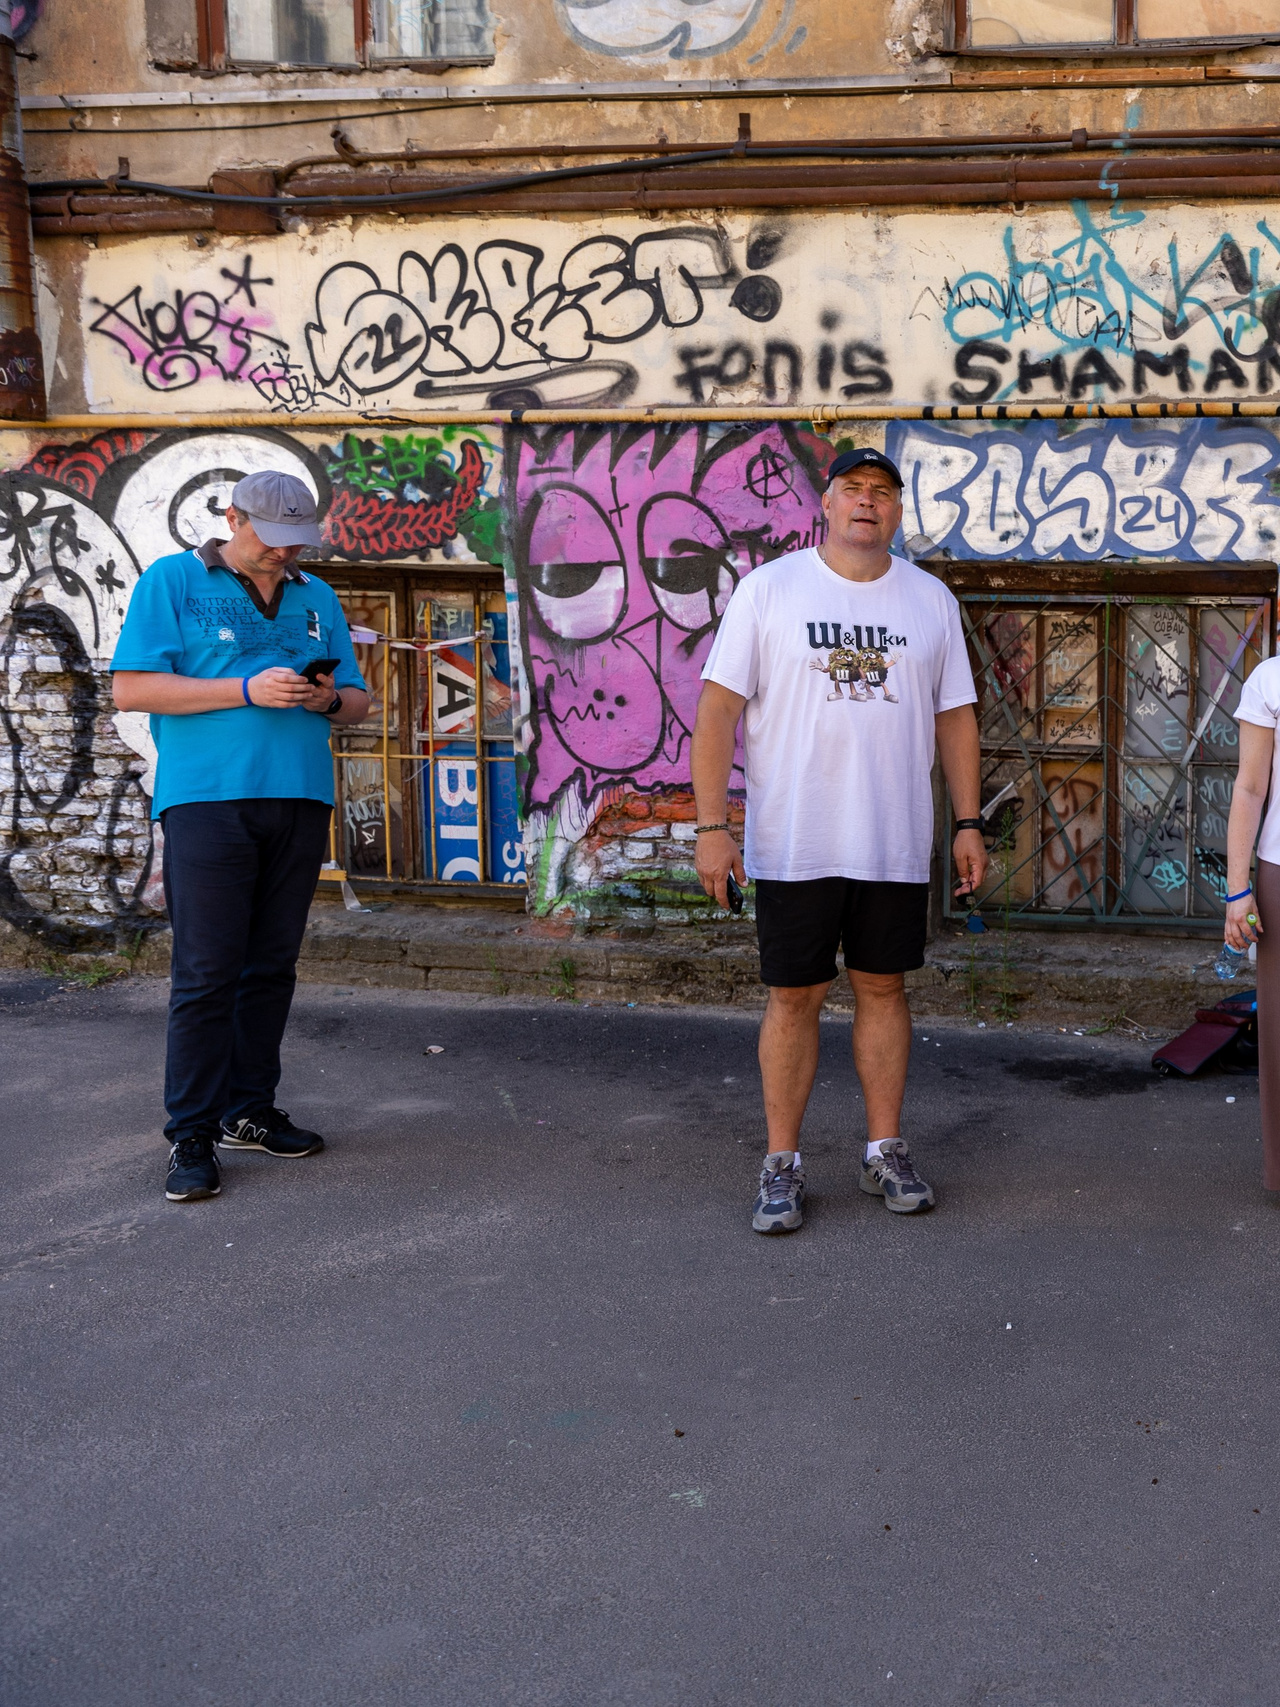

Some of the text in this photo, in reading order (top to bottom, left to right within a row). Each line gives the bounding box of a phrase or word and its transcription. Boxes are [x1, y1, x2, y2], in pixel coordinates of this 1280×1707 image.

[186, 597, 251, 608] OUTDOOR
[189, 606, 256, 618] WORLD
[194, 614, 256, 628] TRAVEL
